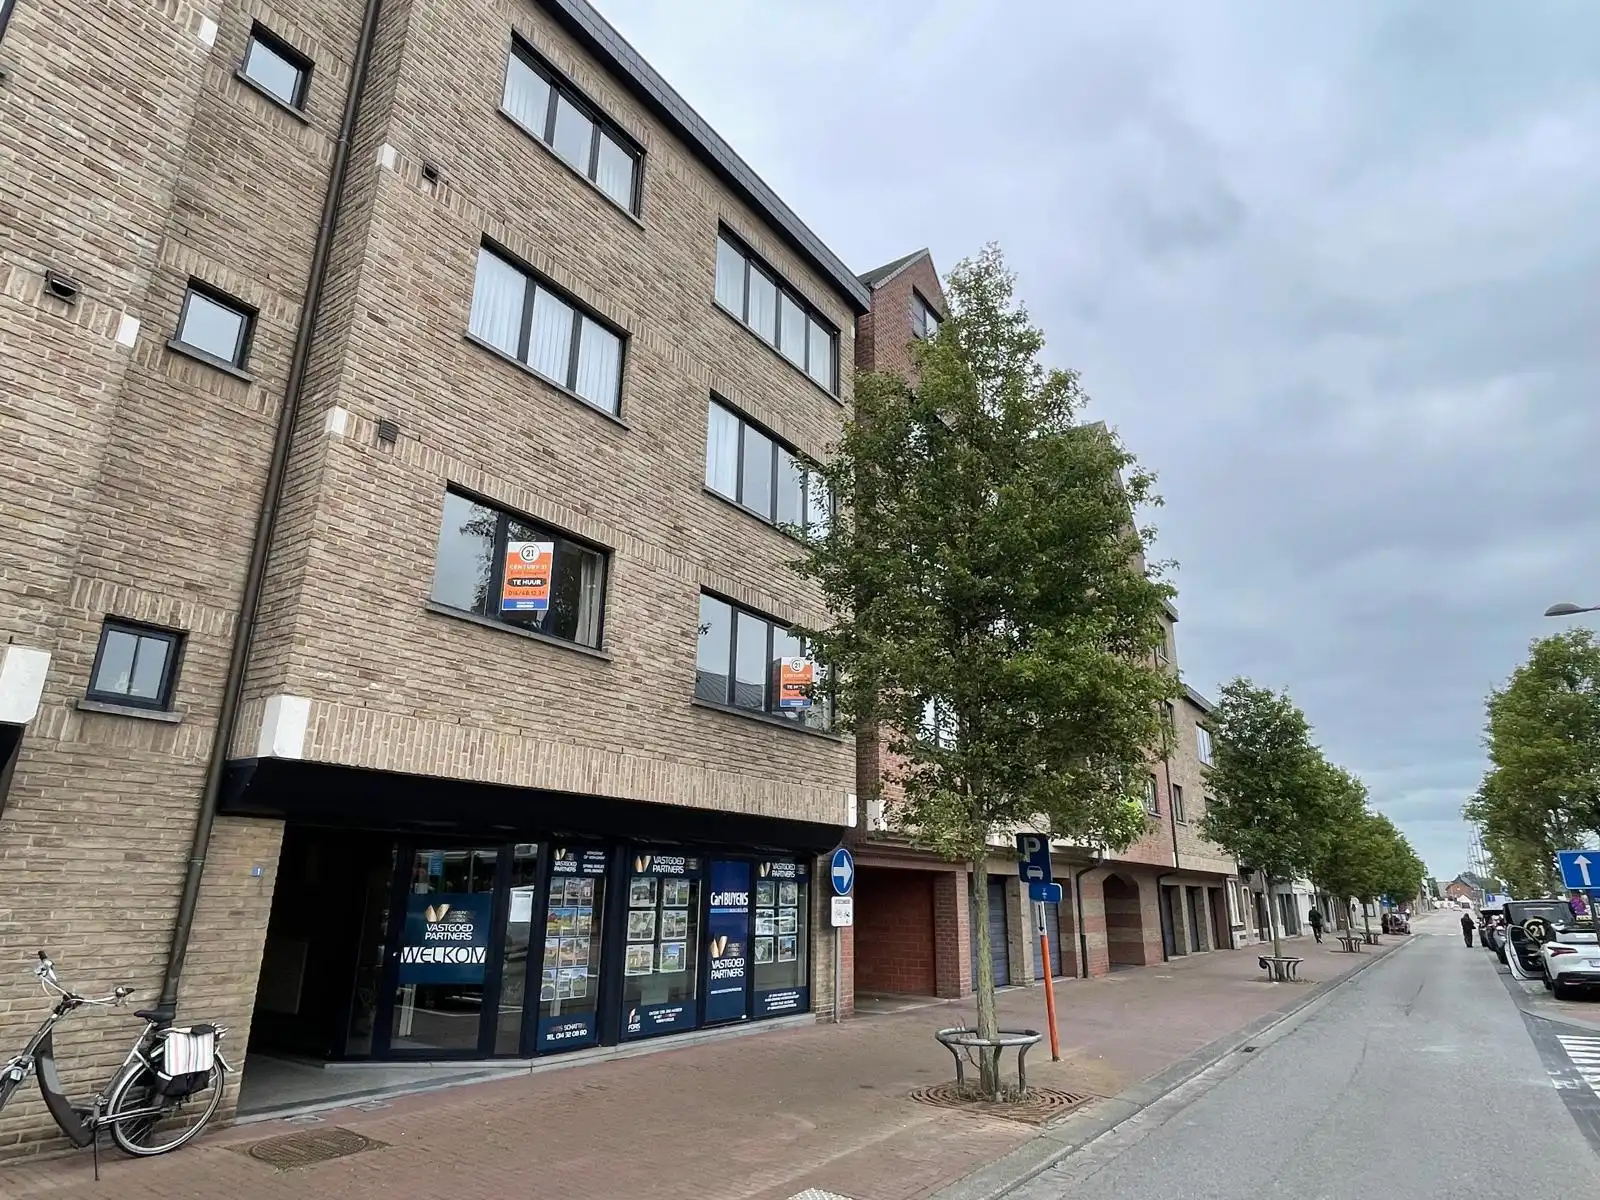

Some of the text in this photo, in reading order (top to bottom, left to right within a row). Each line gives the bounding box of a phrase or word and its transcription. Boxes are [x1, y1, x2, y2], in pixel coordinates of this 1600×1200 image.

[525, 549, 534, 557] 21
[1024, 837, 1041, 862] P
[653, 855, 685, 865] VASTGOED
[652, 864, 685, 874] PARTNERS
[771, 862, 796, 870] VASTGOED
[771, 870, 796, 878] PARTNERS
[724, 892, 749, 906] BUYENS
[426, 923, 474, 932] VASTGOED
[1530, 924, 1546, 937] 21
[424, 932, 473, 941] PARTNERS
[400, 946, 486, 963] WELKOM
[711, 958, 745, 970] VASTGOED
[711, 968, 744, 980] PARTNERS
